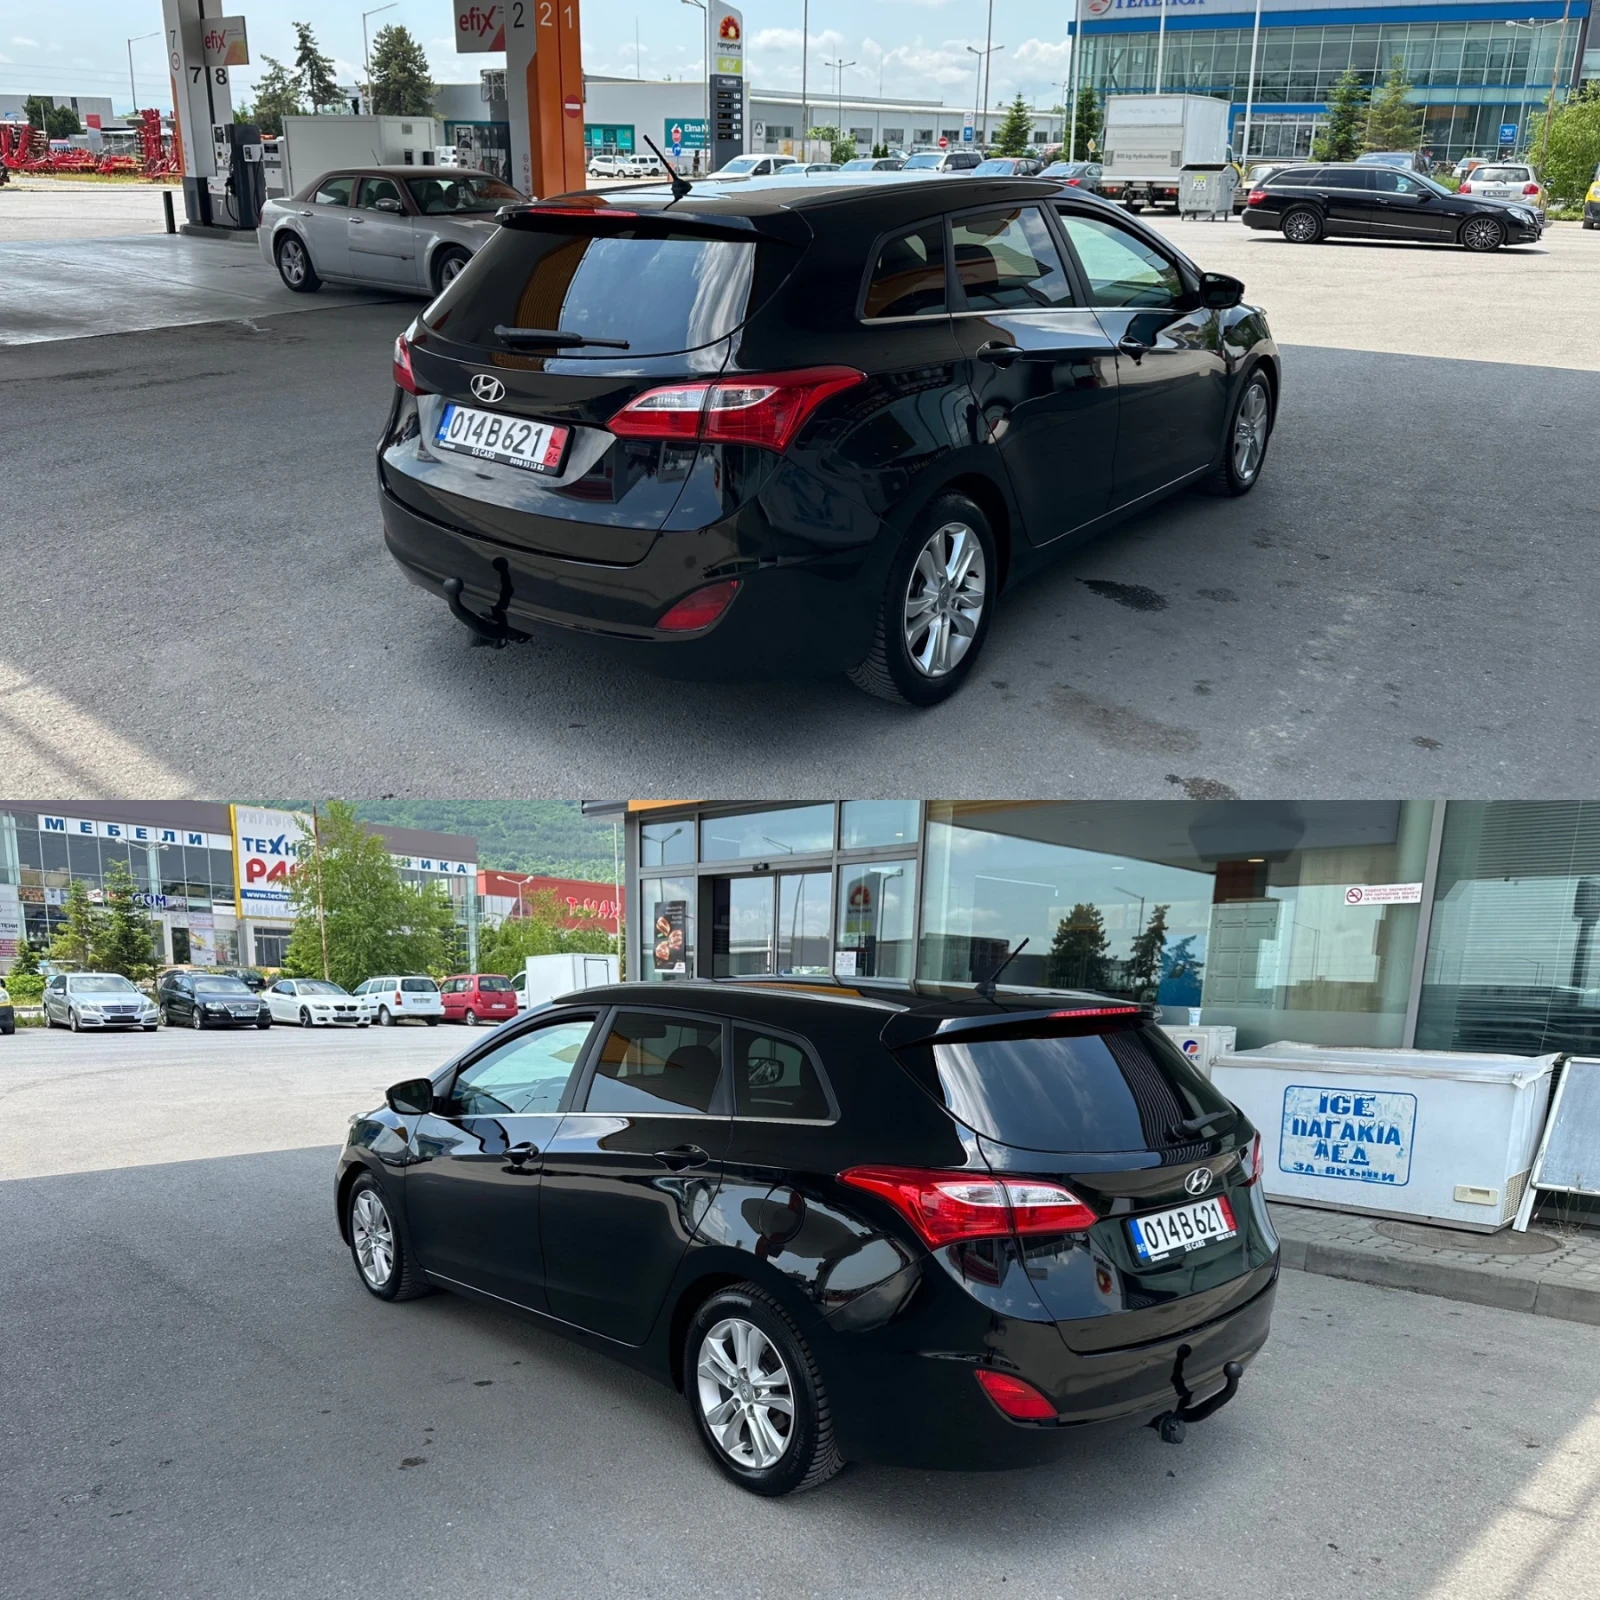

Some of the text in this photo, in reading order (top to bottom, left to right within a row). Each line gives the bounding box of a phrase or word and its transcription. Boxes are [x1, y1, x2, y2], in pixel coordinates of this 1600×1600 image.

[459, 5, 496, 38] efix
[512, 2, 525, 28] 2
[540, 2, 552, 26] 2
[564, 5, 573, 29] 1
[170, 29, 176, 49] 7
[204, 29, 227, 54] efix
[717, 41, 742, 51] rompetrol
[189, 66, 202, 84] 7
[215, 67, 227, 85] 8
[450, 410, 544, 458] 014B621
[480, 449, 496, 460] CARS
[44, 817, 202, 846] МЕБЕЛИ
[1319, 1090, 1377, 1118] ICE
[1293, 1162, 1315, 1173] ЗА
[1136, 1243, 1147, 1254] BG
[1143, 1202, 1224, 1250] 014B621
